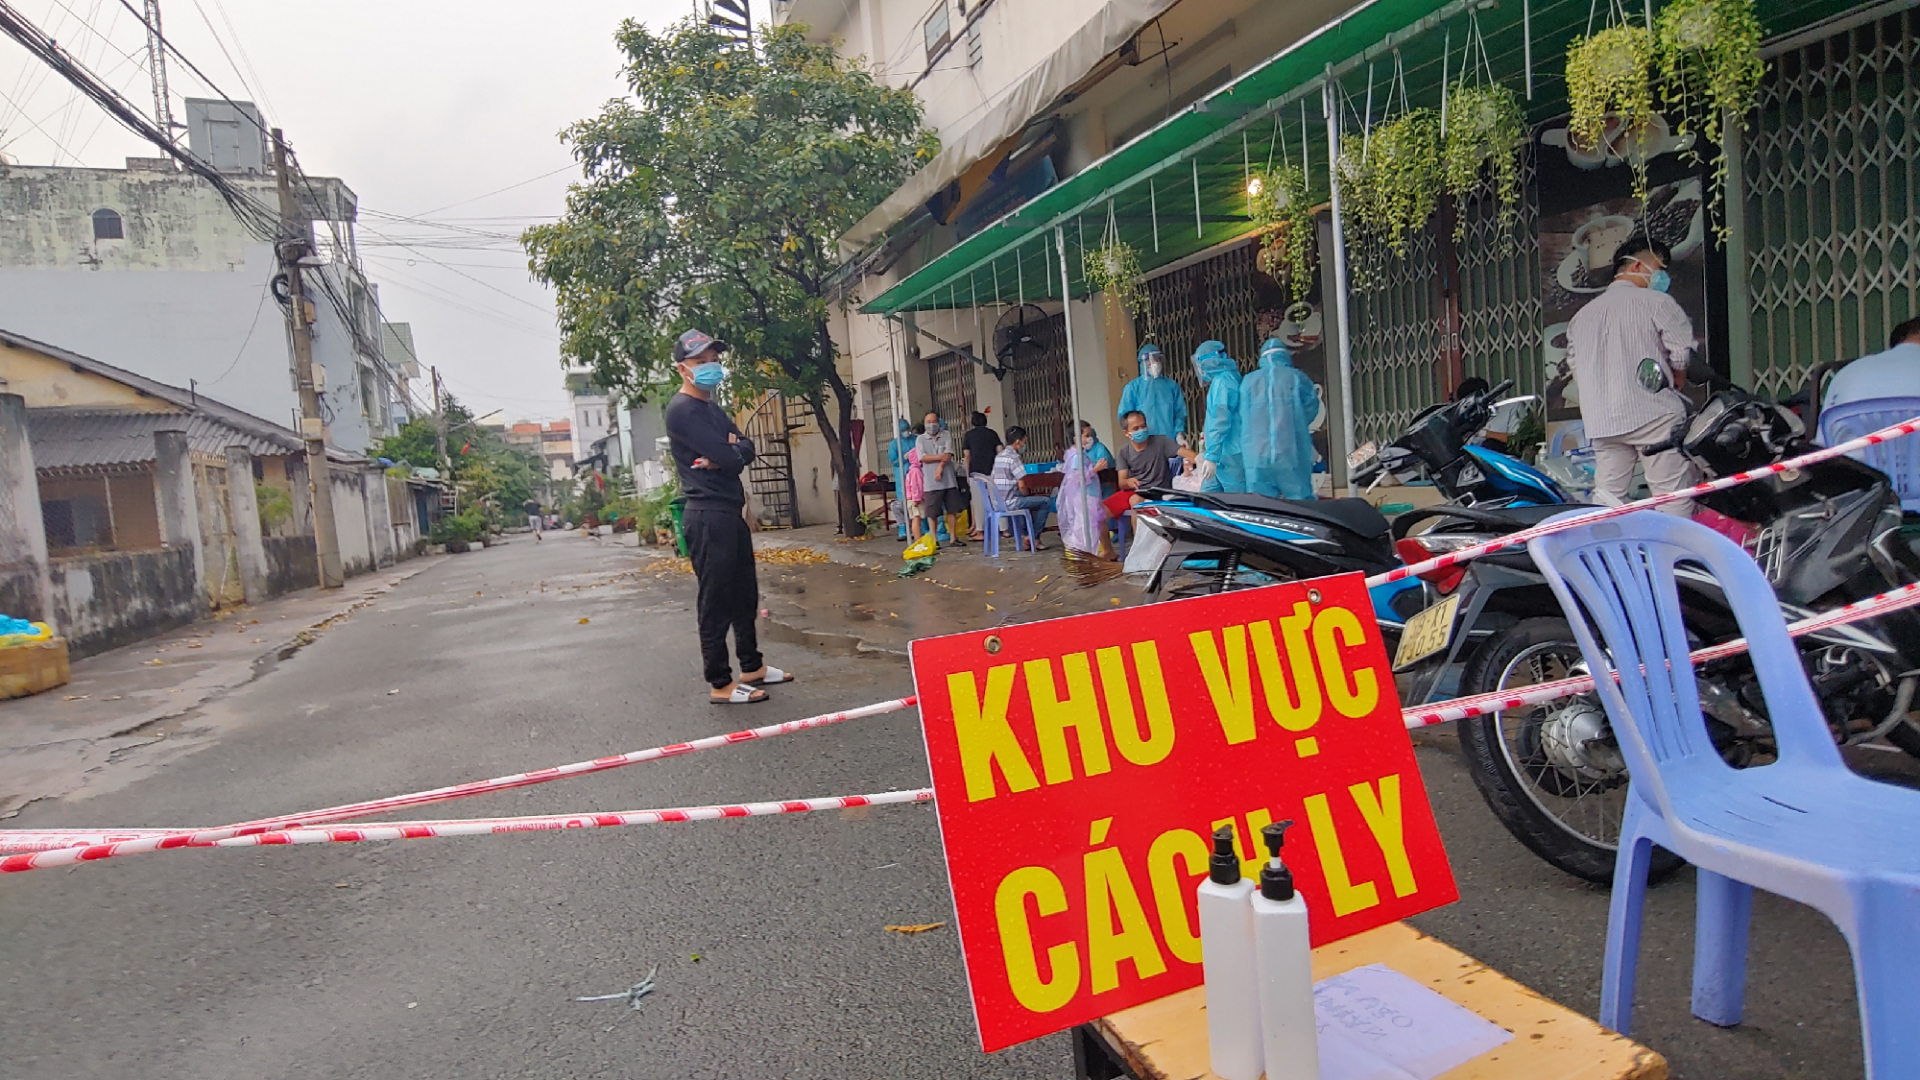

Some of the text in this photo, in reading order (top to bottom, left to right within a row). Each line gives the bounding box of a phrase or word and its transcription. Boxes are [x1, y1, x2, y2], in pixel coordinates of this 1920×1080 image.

[946, 601, 1378, 803] KHU VỰC
[1305, 775, 1417, 916] LY
